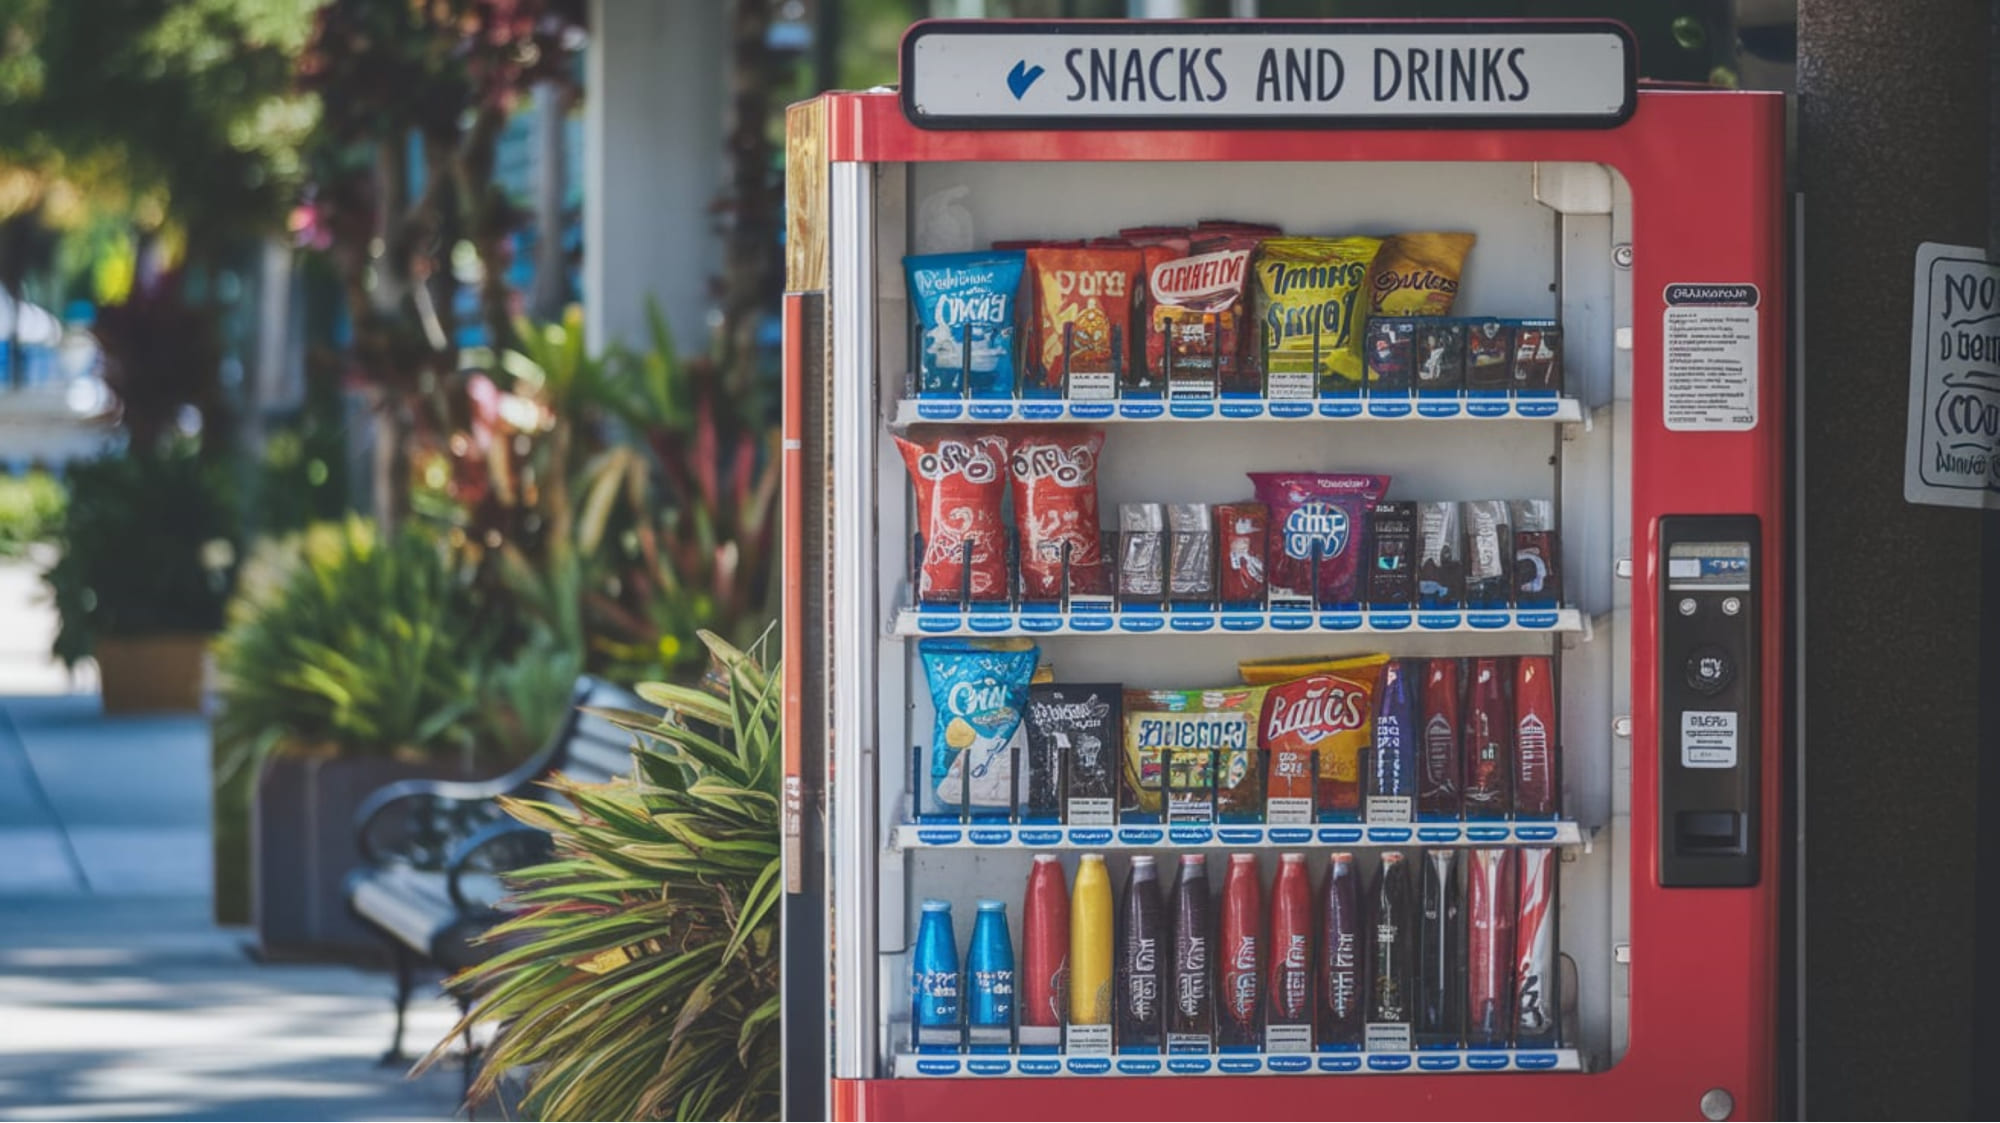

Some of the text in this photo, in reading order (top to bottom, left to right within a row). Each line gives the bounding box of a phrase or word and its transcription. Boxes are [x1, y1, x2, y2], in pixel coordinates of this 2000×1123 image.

[1065, 48, 1530, 102] SNACKS AND DRINKS
